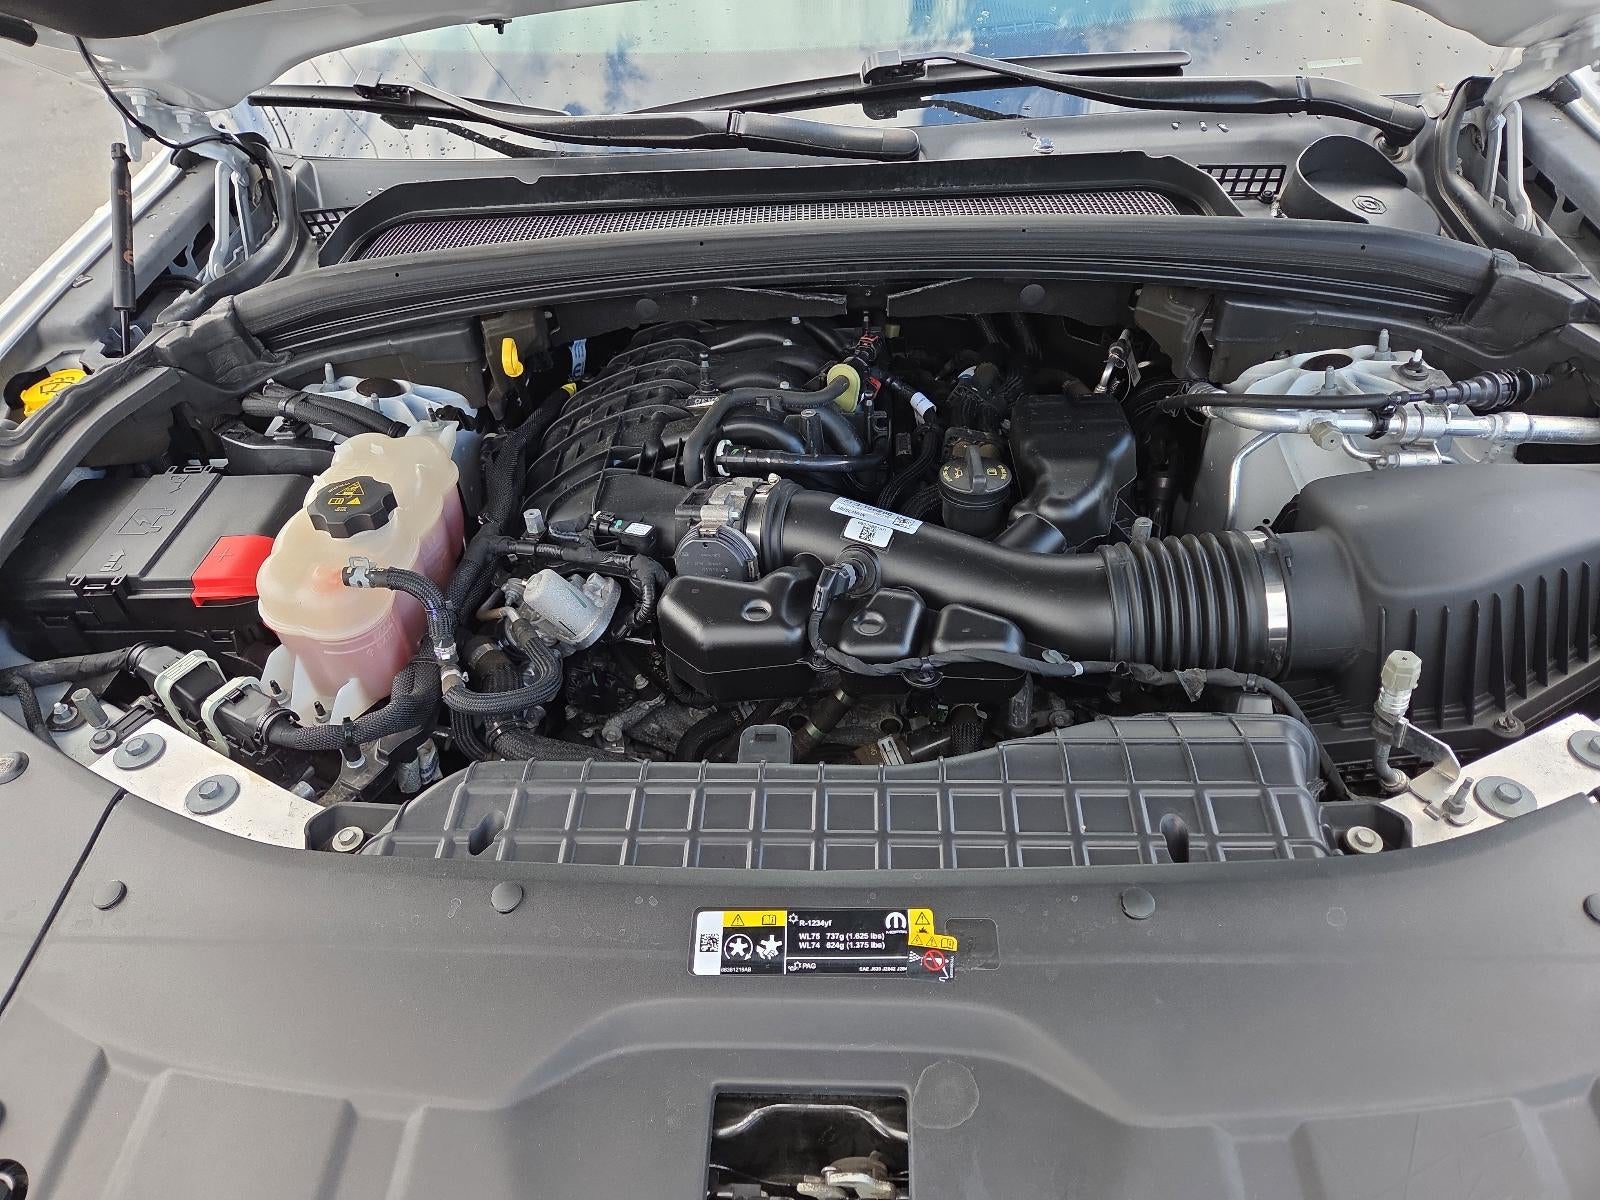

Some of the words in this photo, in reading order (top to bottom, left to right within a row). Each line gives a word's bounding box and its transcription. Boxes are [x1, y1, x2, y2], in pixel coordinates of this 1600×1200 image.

[799, 919, 832, 928] R-1234yf
[825, 932, 845, 941] 737g
[799, 941, 821, 949] WL74
[802, 962, 817, 970] PAG
